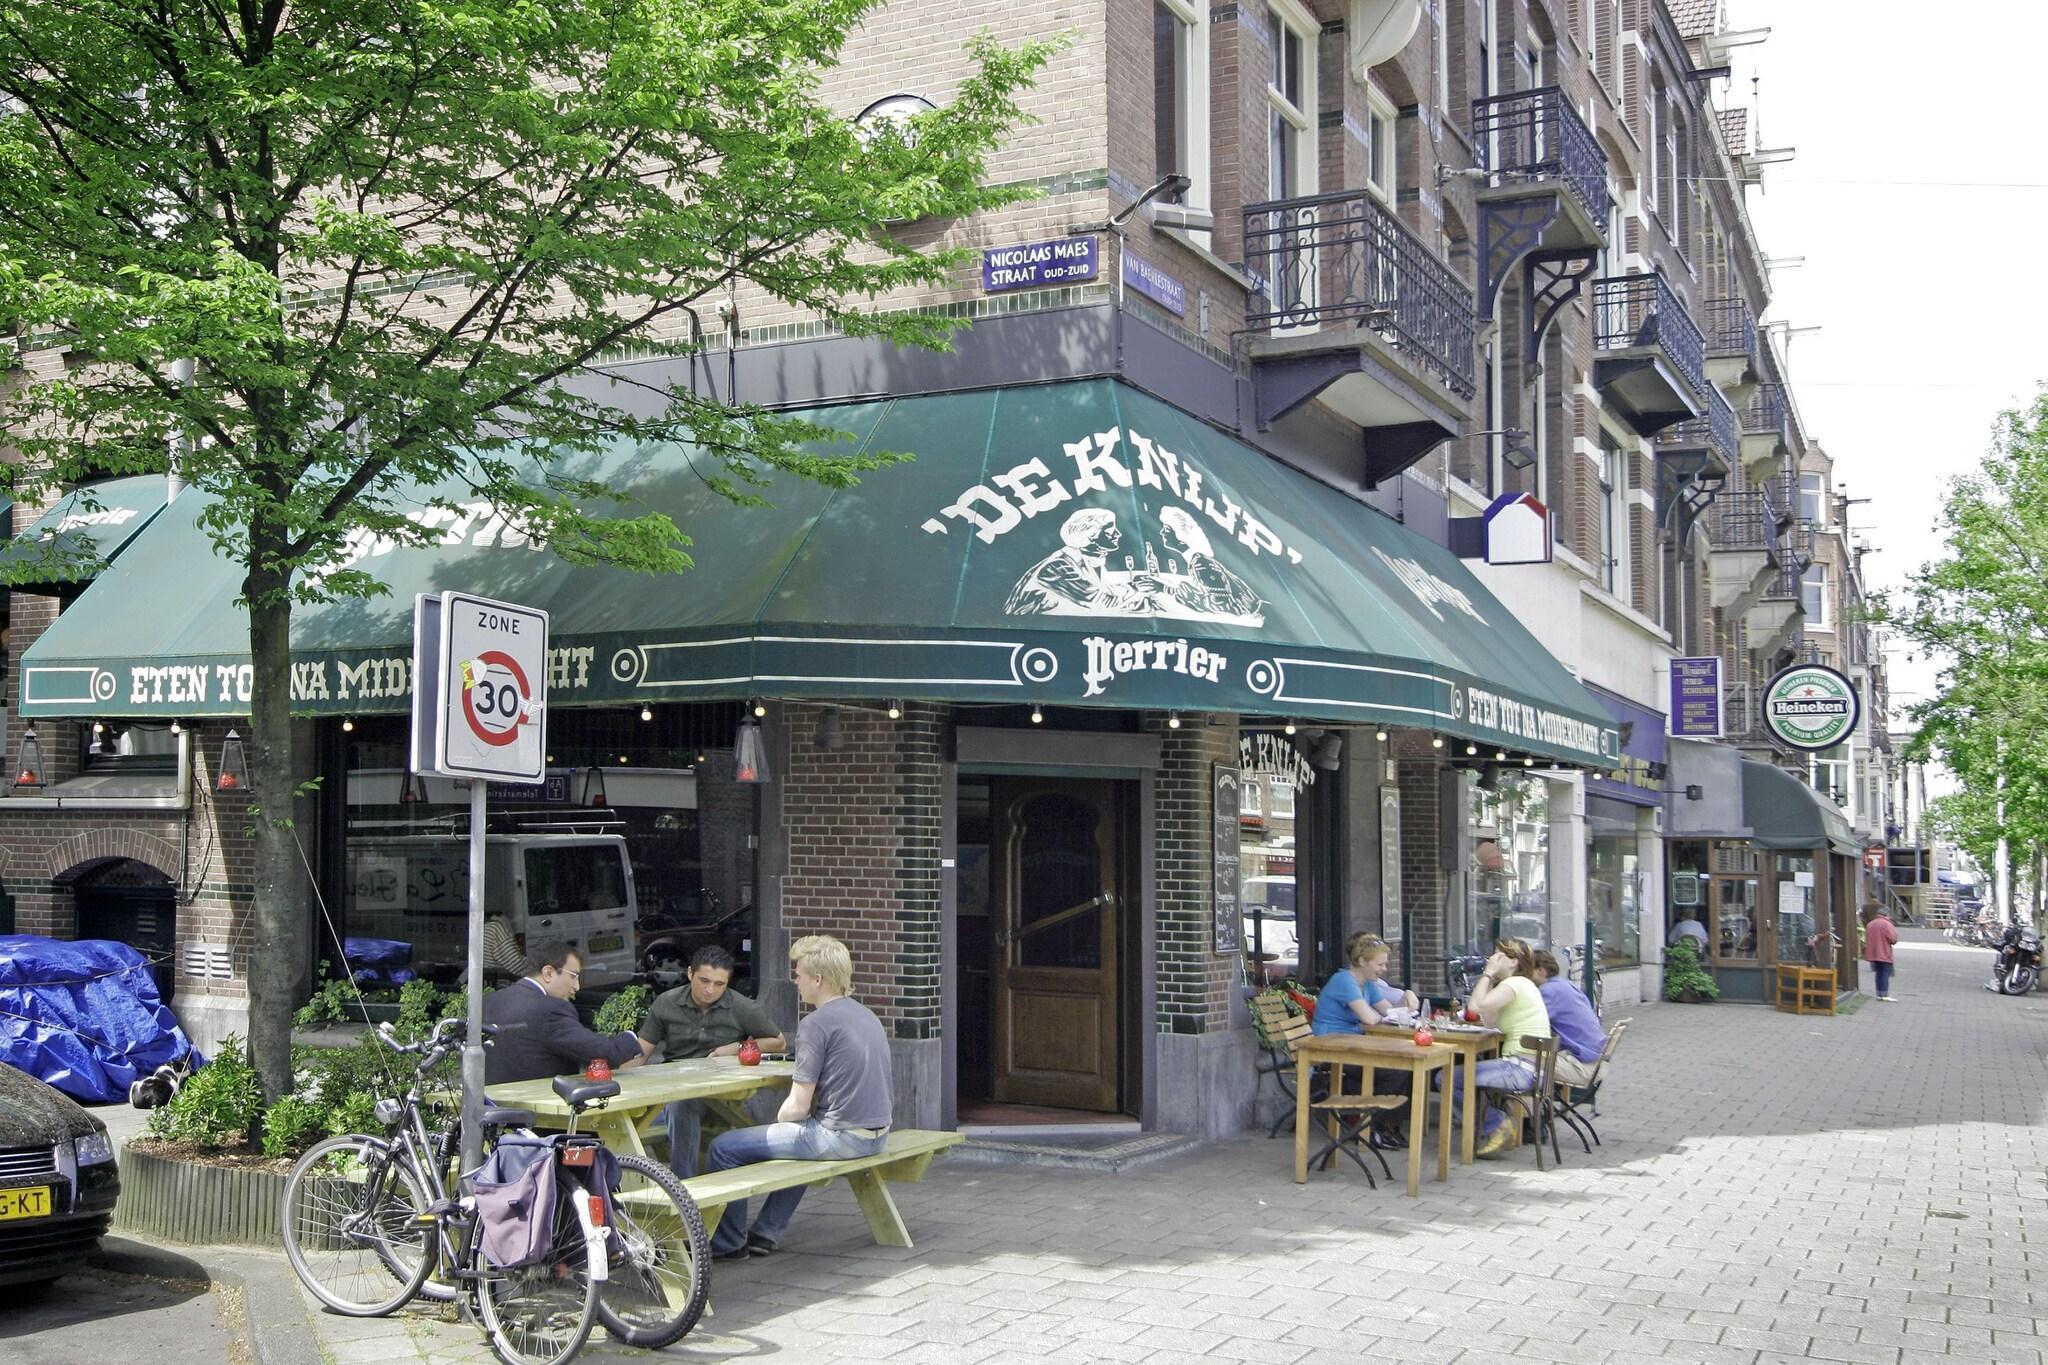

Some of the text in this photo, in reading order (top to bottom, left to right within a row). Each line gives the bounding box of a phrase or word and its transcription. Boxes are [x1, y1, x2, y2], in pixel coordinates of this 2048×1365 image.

[991, 241, 1089, 268] NICOLAAS MAES
[1125, 253, 1139, 275] VAN
[991, 264, 1089, 285] STRAAT OUD-ZUID
[478, 611, 521, 636] ZONE
[1082, 636, 1227, 698] Perrier
[130, 664, 209, 705] ETEN
[216, 663, 254, 703] TO
[289, 661, 330, 701] NA
[475, 680, 518, 718] 30
[1776, 701, 1844, 713] Heineken
[1467, 687, 1600, 756] ETEN TOT NA MIDDERNACHT
[1782, 720, 1840, 739] PREMIUM QUALITY
